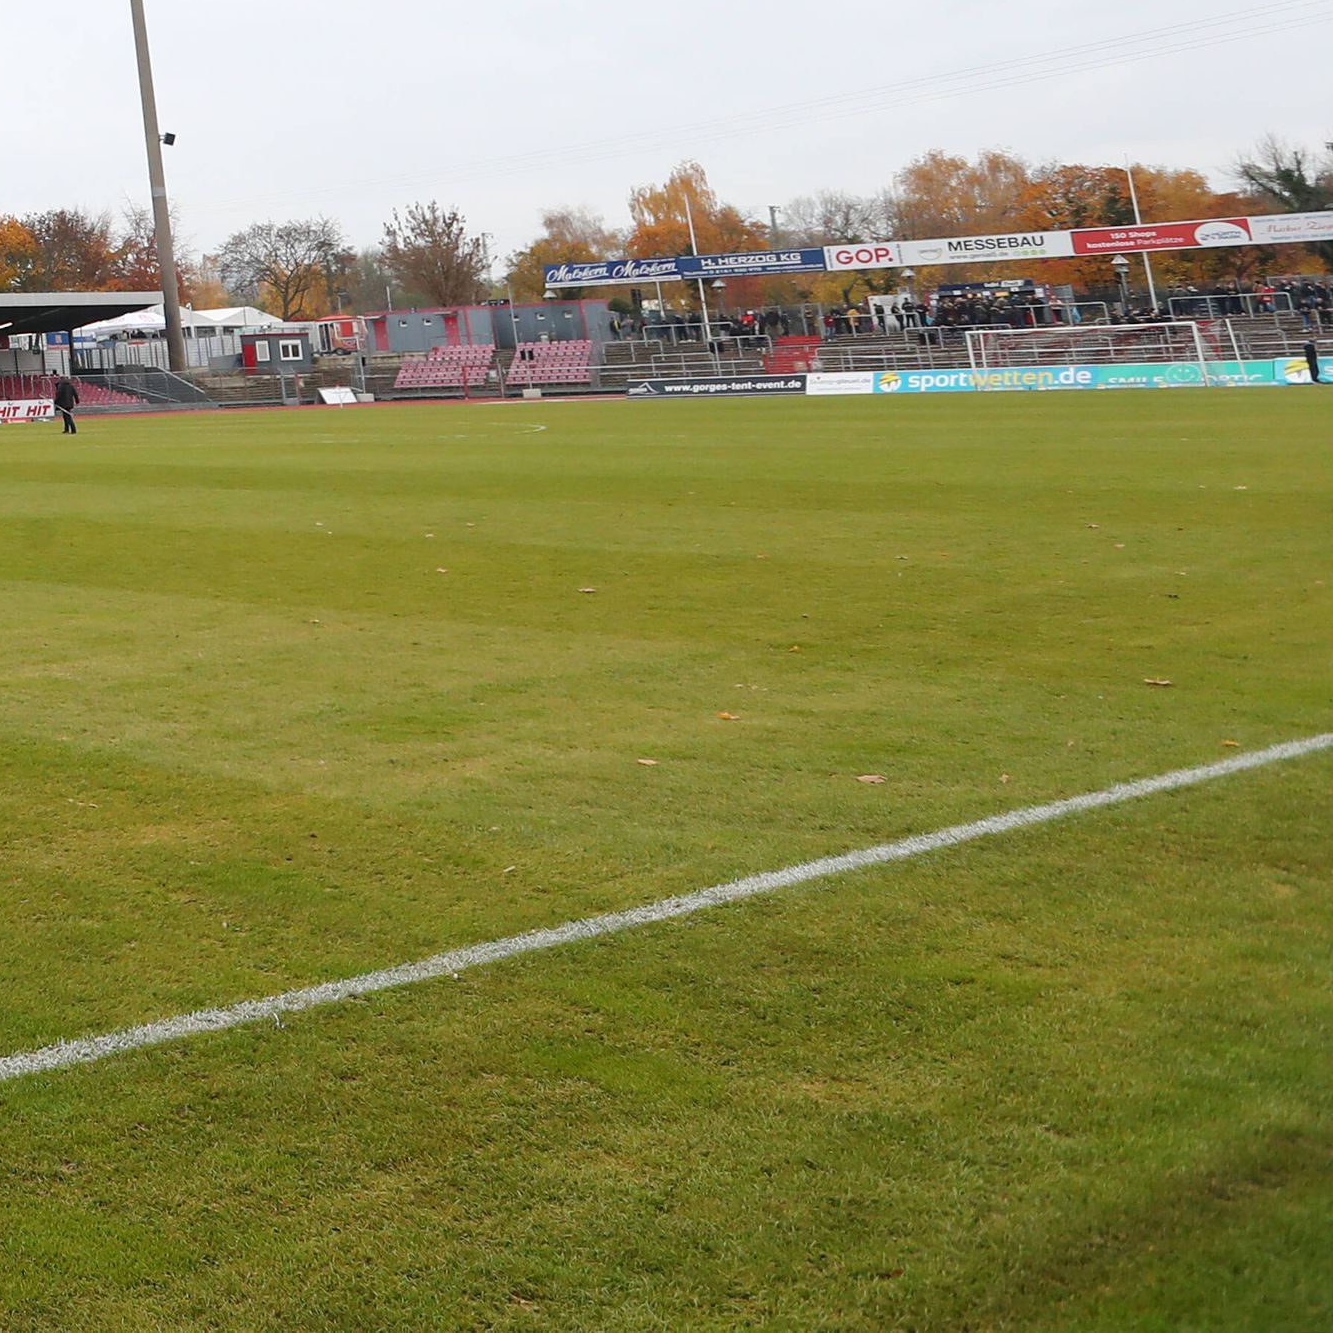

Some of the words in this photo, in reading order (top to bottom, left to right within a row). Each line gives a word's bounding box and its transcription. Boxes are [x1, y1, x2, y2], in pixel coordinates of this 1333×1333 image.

[1128, 229, 1157, 239] Shops
[947, 235, 1045, 252] MESSEBAU
[701, 259, 716, 267] H.
[718, 255, 777, 266] HERZOG
[780, 252, 802, 263] KG
[664, 380, 802, 393] www.gorges-tent-event.de
[908, 367, 1092, 392] sportwetten.de
[26, 404, 52, 416] HIT
